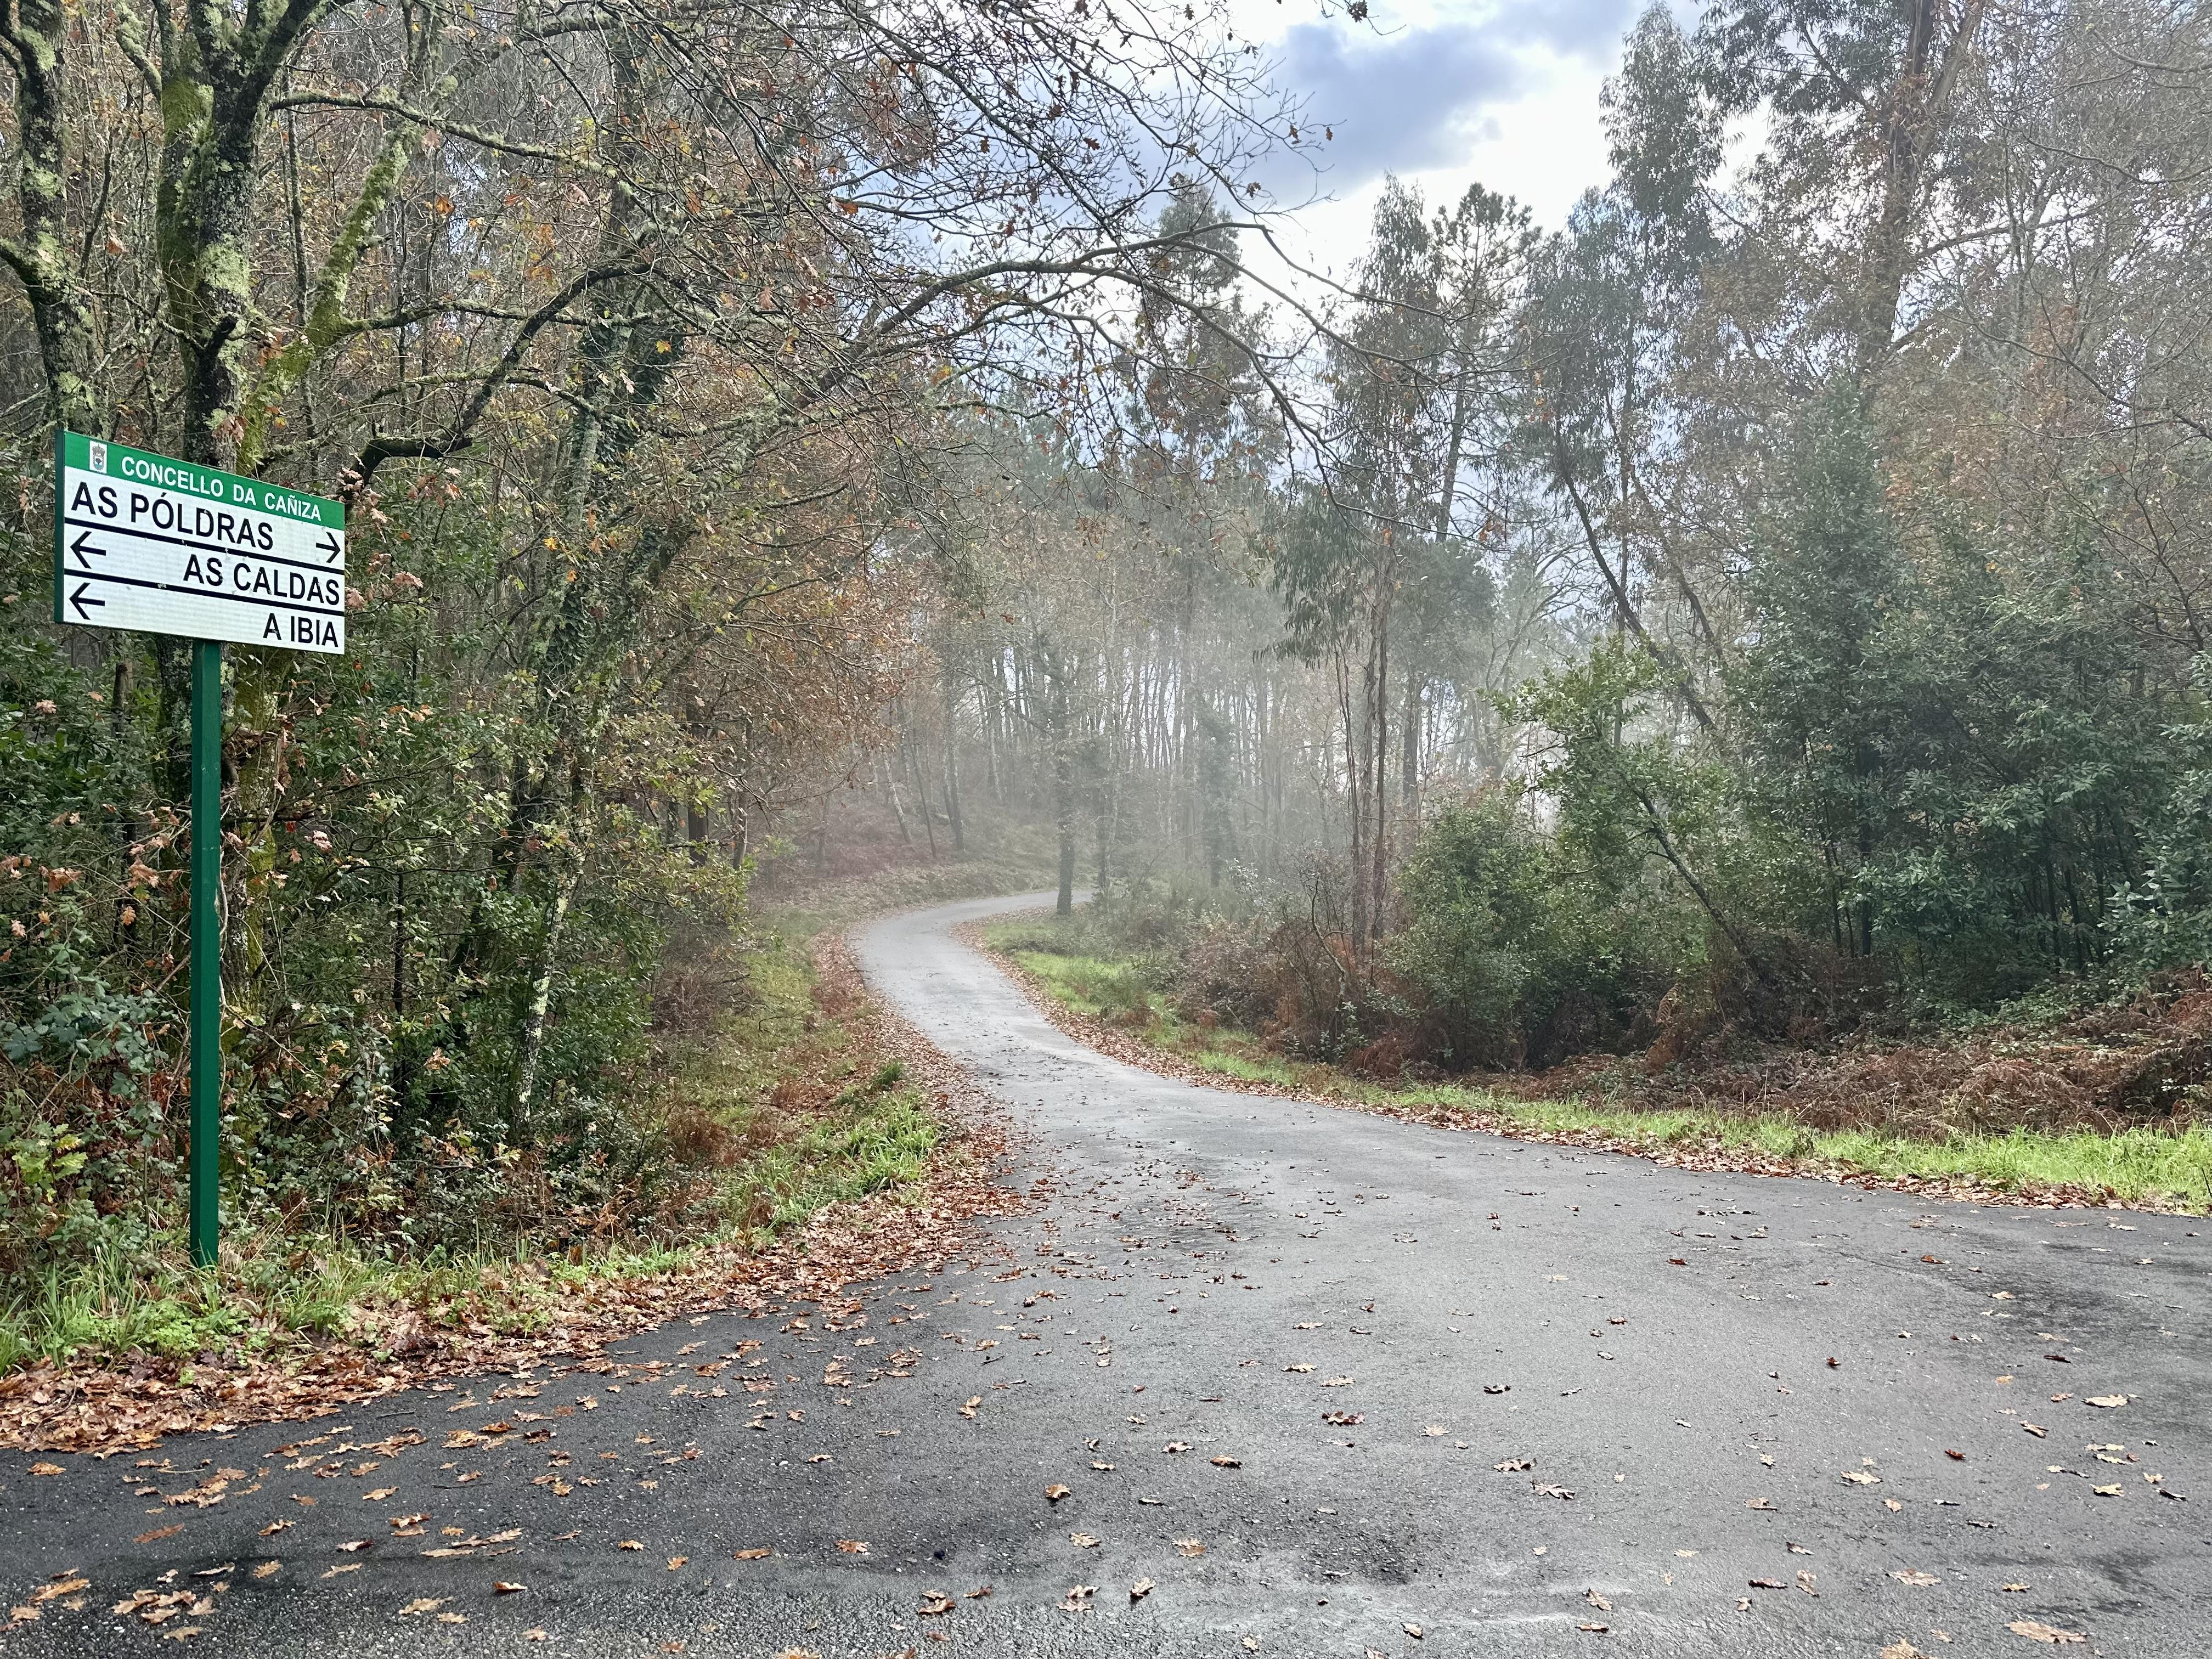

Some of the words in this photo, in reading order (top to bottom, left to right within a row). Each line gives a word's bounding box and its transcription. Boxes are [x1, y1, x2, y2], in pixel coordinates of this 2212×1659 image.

[71, 481, 118, 518] AS
[131, 492, 273, 550] PÓLDRAS
[122, 456, 223, 497] CONCELLO
[233, 484, 256, 506] DA
[264, 492, 321, 521] CAÑIZA
[183, 554, 223, 586] AS
[234, 563, 340, 605] CALDAS
[263, 612, 282, 640] A
[290, 615, 338, 647] IBIA
